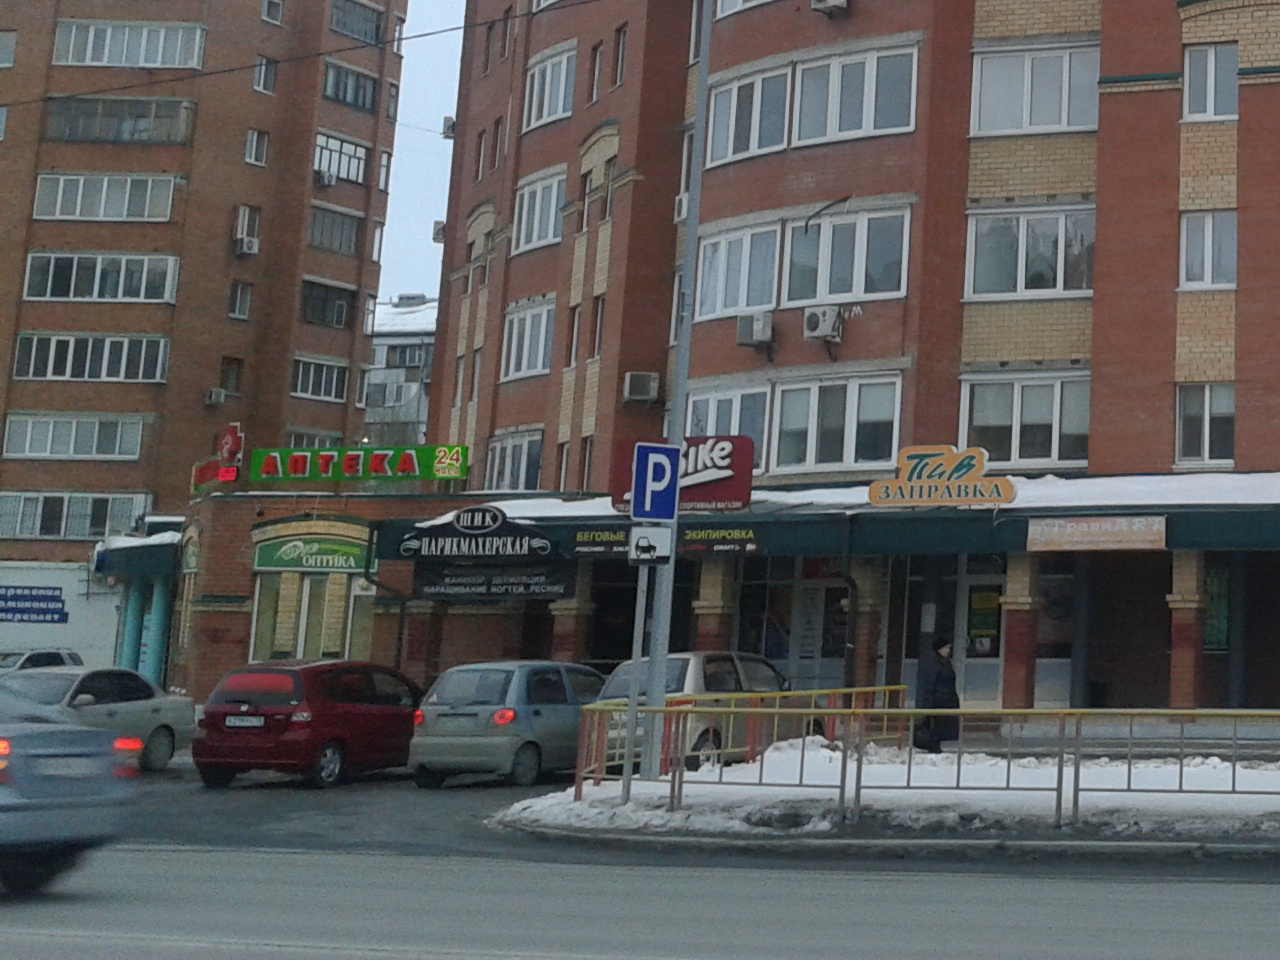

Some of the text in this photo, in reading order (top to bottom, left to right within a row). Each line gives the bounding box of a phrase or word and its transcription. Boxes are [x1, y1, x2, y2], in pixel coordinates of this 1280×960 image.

[260, 450, 419, 478] АПТЕКА
[434, 447, 462, 466] 24
[878, 483, 1004, 500] ЗАПРАВКА
[459, 512, 495, 527] ШИК
[576, 530, 626, 542] БЕГОВЫЕ
[684, 529, 755, 540] ЭКИПИРОВКА
[421, 535, 530, 556] ПАРИКМАХЕРСКАЯ
[302, 555, 356, 568] ОПТИКА
[423, 585, 488, 594] НАРАЩИВАНИЕ
